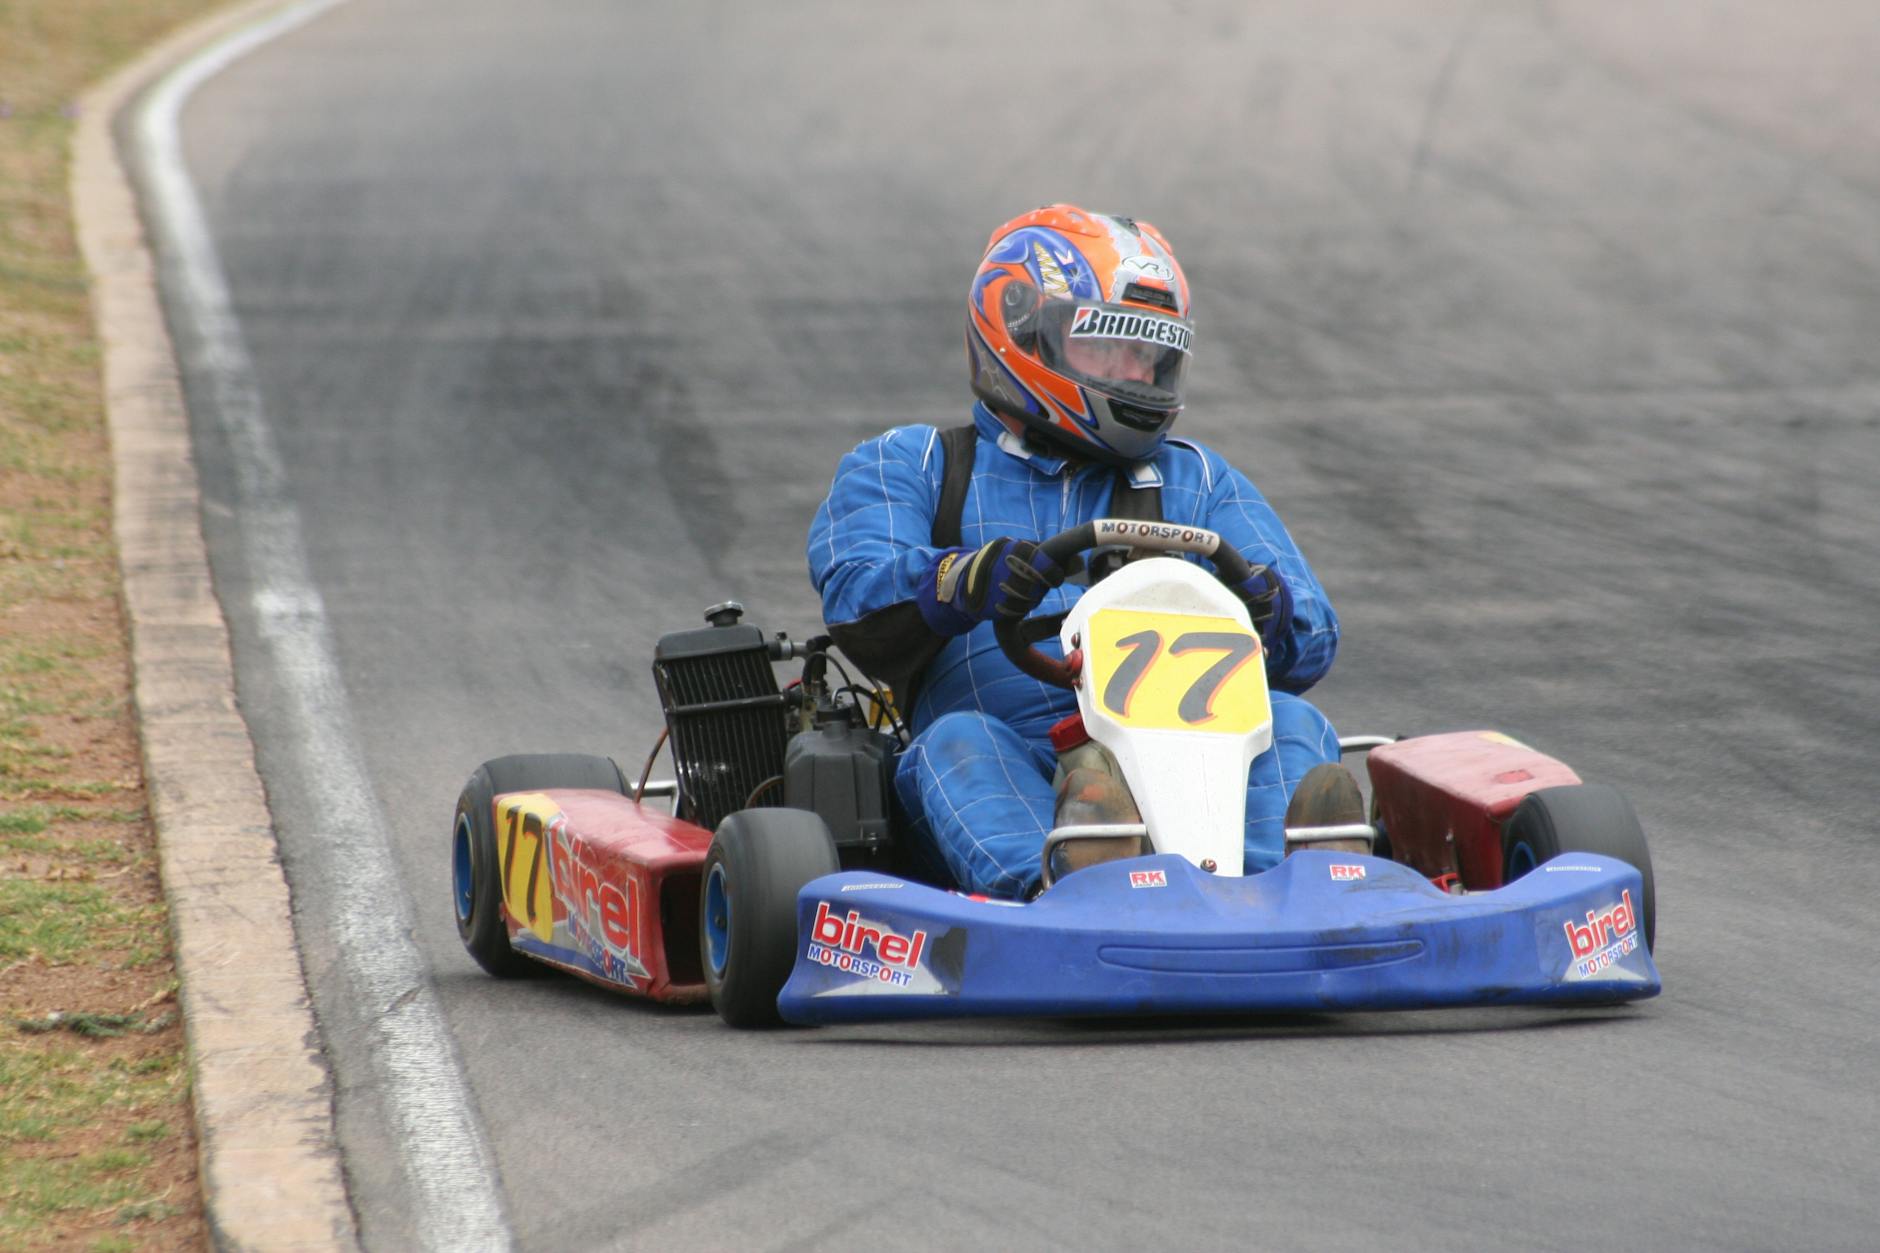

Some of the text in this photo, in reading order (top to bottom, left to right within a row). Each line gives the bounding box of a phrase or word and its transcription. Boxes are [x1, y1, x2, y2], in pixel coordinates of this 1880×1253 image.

[1071, 307, 1192, 353] BRIDGESTO
[1102, 522, 1214, 545] MOTORSPORT
[1103, 629, 1263, 726] 17
[503, 804, 545, 927] 17
[1131, 871, 1165, 885] RK
[1331, 866, 1364, 879] RK
[549, 818, 641, 962] birel
[811, 901, 926, 969] birel
[1564, 891, 1635, 960] birel
[807, 944, 912, 987] MOTORSPORT
[1578, 933, 1638, 978] MOTORSPORT
